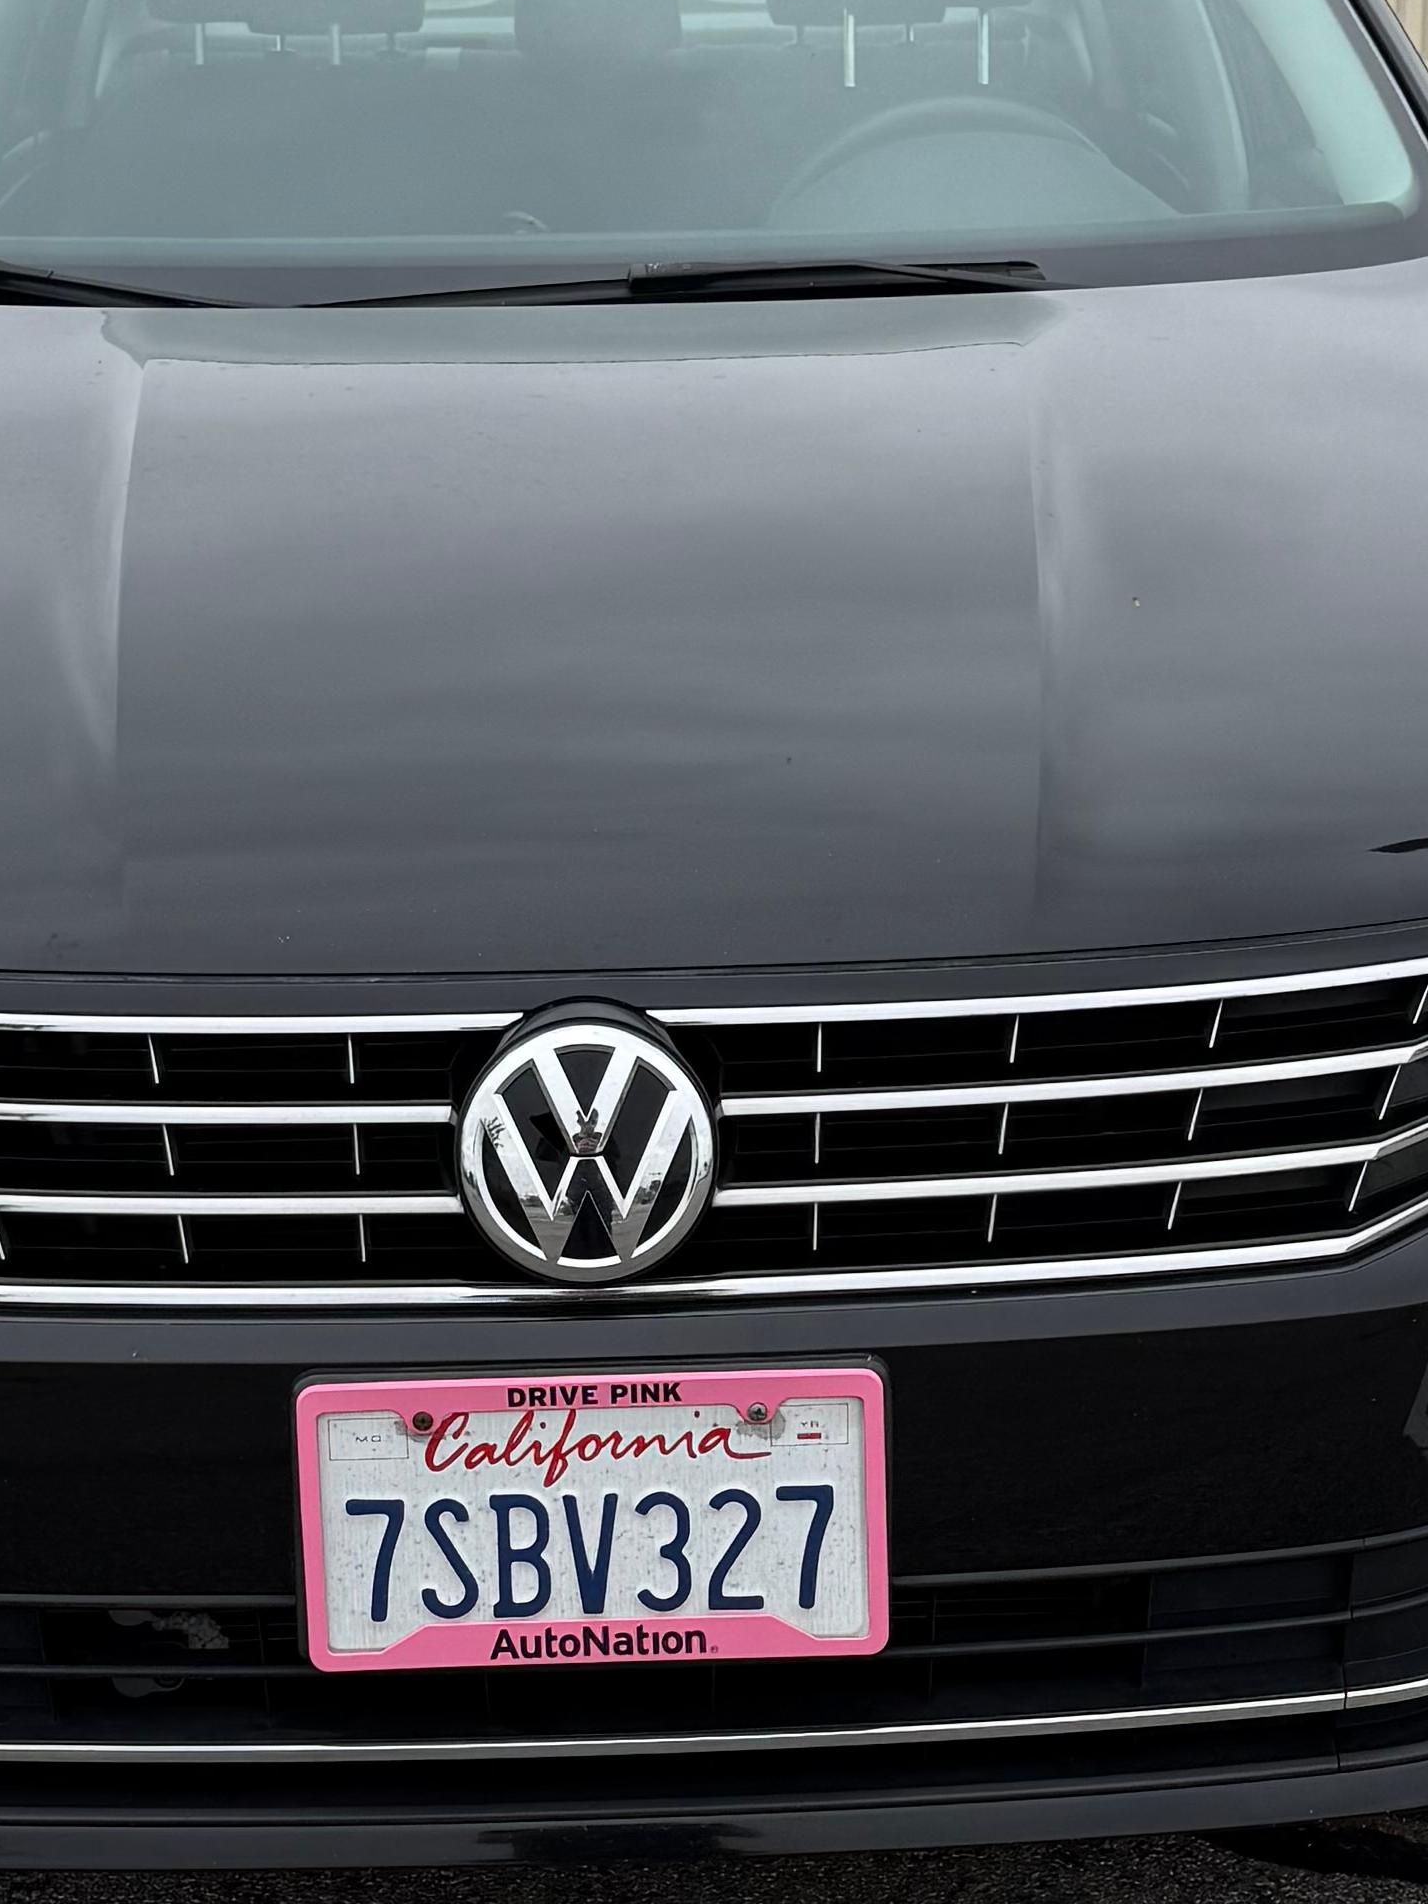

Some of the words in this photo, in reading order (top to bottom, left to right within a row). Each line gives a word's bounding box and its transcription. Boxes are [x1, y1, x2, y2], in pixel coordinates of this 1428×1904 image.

[507, 1385, 599, 1408] DRIVE
[610, 1382, 682, 1405] PINK
[355, 1434, 381, 1442] MO
[424, 1409, 772, 1488] California
[345, 1484, 834, 1623] 7SBV327
[490, 1624, 707, 1660] AutoNation
